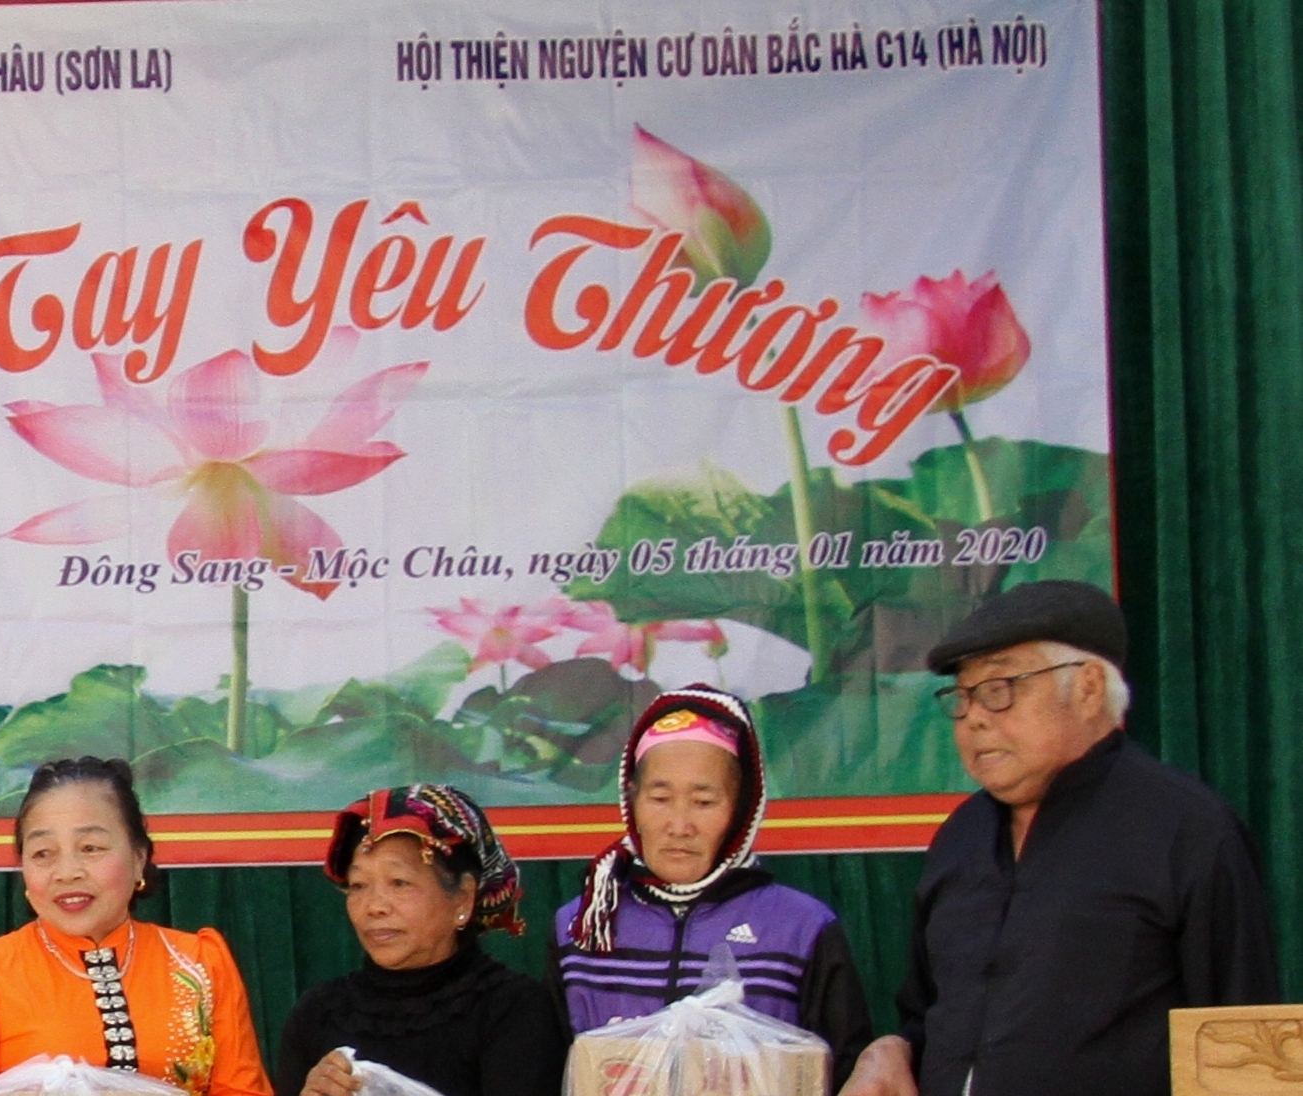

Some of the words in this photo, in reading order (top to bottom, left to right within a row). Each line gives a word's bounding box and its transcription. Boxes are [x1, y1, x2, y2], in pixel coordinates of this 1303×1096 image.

[55, 47, 122, 97] (SƠN
[131, 47, 174, 93] LA)
[396, 33, 442, 90] HỘI
[451, 34, 529, 88] THIỆN
[538, 30, 648, 88] NGUYỆN
[656, 33, 697, 78] CƯ
[701, 28, 757, 77] DÂN
[767, 17, 822, 76] BẮC
[830, 23, 868, 73] HÀ
[876, 31, 929, 71] C14
[936, 17, 984, 71] (HÀ
[993, 16, 1048, 76] NỘI)
[241, 197, 487, 378] Yêu
[523, 213, 962, 467] Thương
[56, 554, 161, 594] Đông
[170, 547, 268, 592] Sang
[306, 546, 390, 596] Mộc
[401, 543, 513, 586] Châu,
[527, 541, 619, 589] ngày
[629, 537, 677, 576] 05
[684, 532, 798, 582] tháng
[808, 529, 852, 571] 01
[859, 526, 944, 570] năm
[952, 525, 1047, 567] 2020
